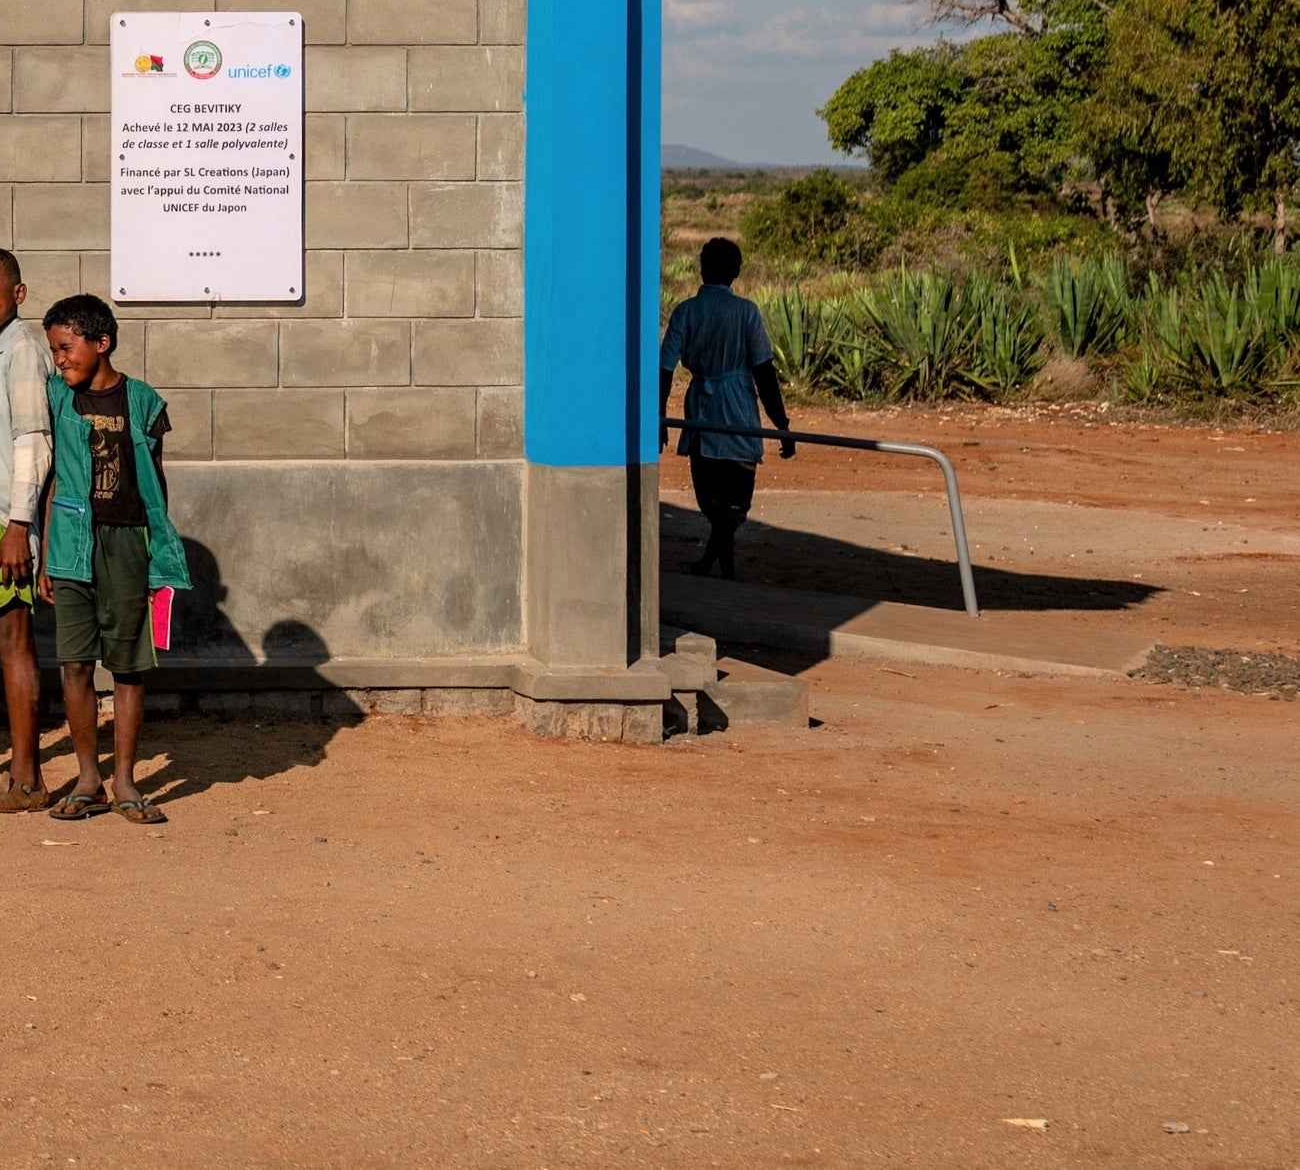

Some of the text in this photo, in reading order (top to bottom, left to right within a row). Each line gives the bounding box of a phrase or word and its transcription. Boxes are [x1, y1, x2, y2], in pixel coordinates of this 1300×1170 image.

[228, 63, 273, 79] unicef
[170, 103, 242, 114] CEG BEVITIKY
[122, 121, 288, 134] Achevé le 12 MAI 2023 (2 salles
[122, 138, 288, 151] de classe et 1 salle polyvalente)
[120, 166, 290, 180] Financé par SL Creations (Japan)
[120, 187, 145, 196] avec
[186, 185, 201, 195] du
[203, 184, 241, 195] Comité
[244, 184, 289, 195] National
[162, 202, 247, 215] UNICEF du Japon
